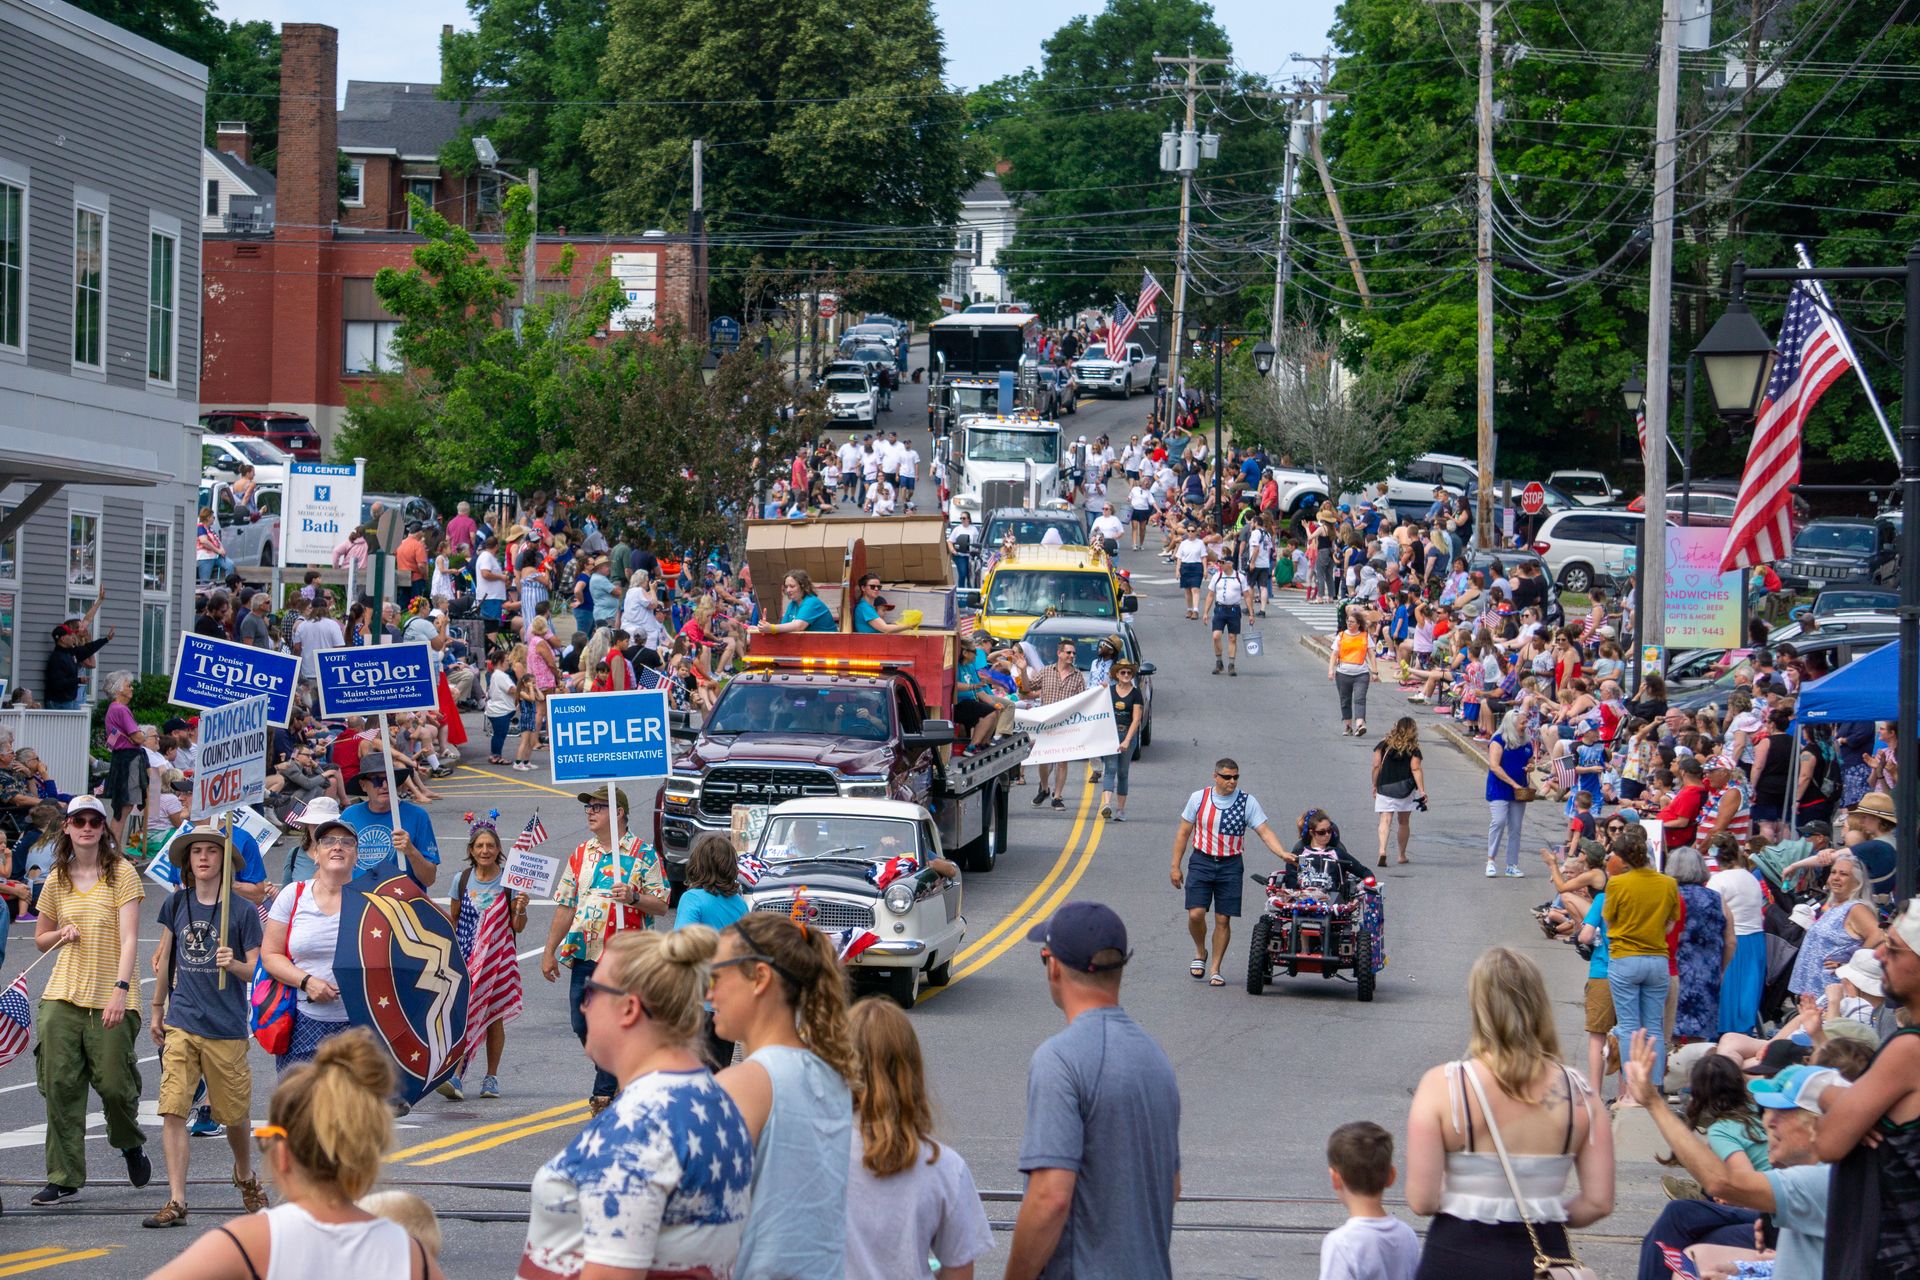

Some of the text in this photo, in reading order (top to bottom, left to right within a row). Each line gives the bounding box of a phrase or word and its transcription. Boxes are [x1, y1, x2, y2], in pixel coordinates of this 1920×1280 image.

[297, 465, 350, 475] 108 CENTRE
[1523, 491, 1543, 505] STOP
[303, 518, 338, 533] Bath
[1665, 590, 1729, 601] ANDWICHES
[1665, 626, 1724, 636] 07 321 9443
[191, 640, 214, 652] VOTE
[218, 655, 244, 667] Denise
[194, 653, 284, 691] Tepler
[331, 660, 420, 687] Tepler
[196, 681, 223, 693] Maine
[343, 685, 416, 698] Maine Senate #24
[554, 705, 586, 714] ALLISON
[204, 700, 265, 744] DEMOCRACY
[556, 717, 663, 746] HEPLER
[202, 731, 264, 768] COUNTS ON YOUR
[557, 749, 664, 764] STATE REPRESENTATIVE
[200, 767, 242, 811] VOTE!
[741, 784, 798, 794] RAM
[519, 854, 549, 864] WOMEN'S
[520, 861, 543, 870] RIGHTS
[510, 864, 550, 880] COUNTS ON YOUR
[507, 873, 534, 889] VOTE!
